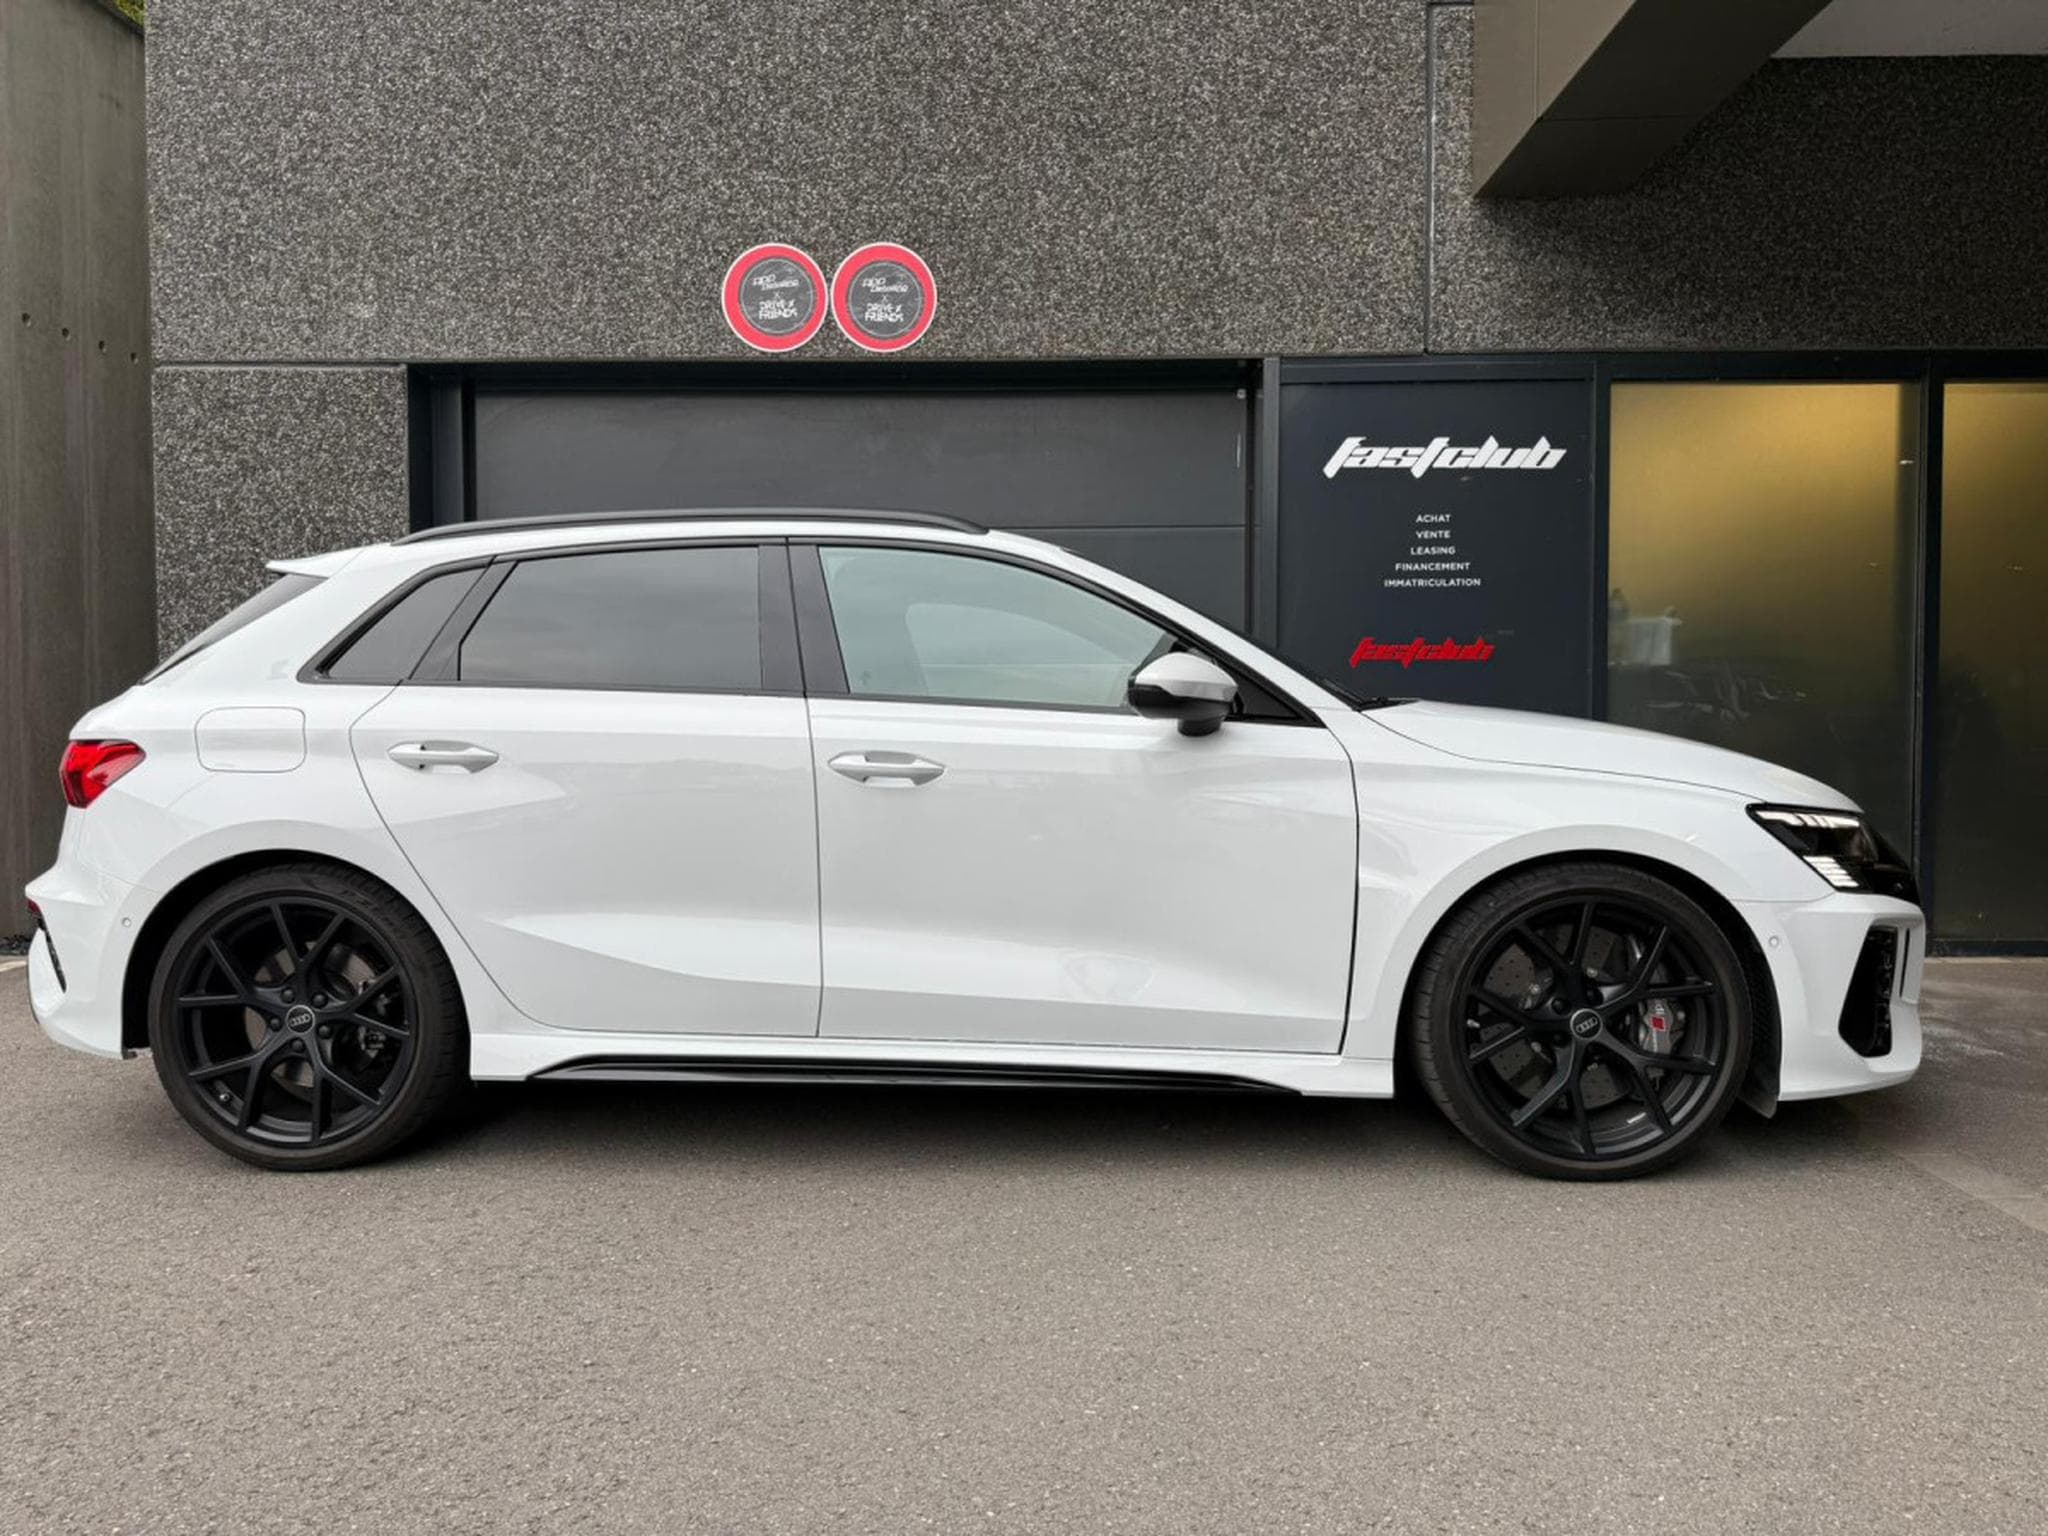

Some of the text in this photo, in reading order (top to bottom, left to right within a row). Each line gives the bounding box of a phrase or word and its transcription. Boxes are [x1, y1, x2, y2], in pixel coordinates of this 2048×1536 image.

[1323, 435, 1567, 479] fastclub
[1416, 514, 1451, 524] ACHAT
[1416, 530, 1451, 539] VENTE
[1410, 546, 1456, 556] LEASING
[1395, 562, 1471, 572] FINANCEMENT
[1384, 577, 1482, 588] IMMATRICULATION
[1350, 636, 1495, 668] fastclub
